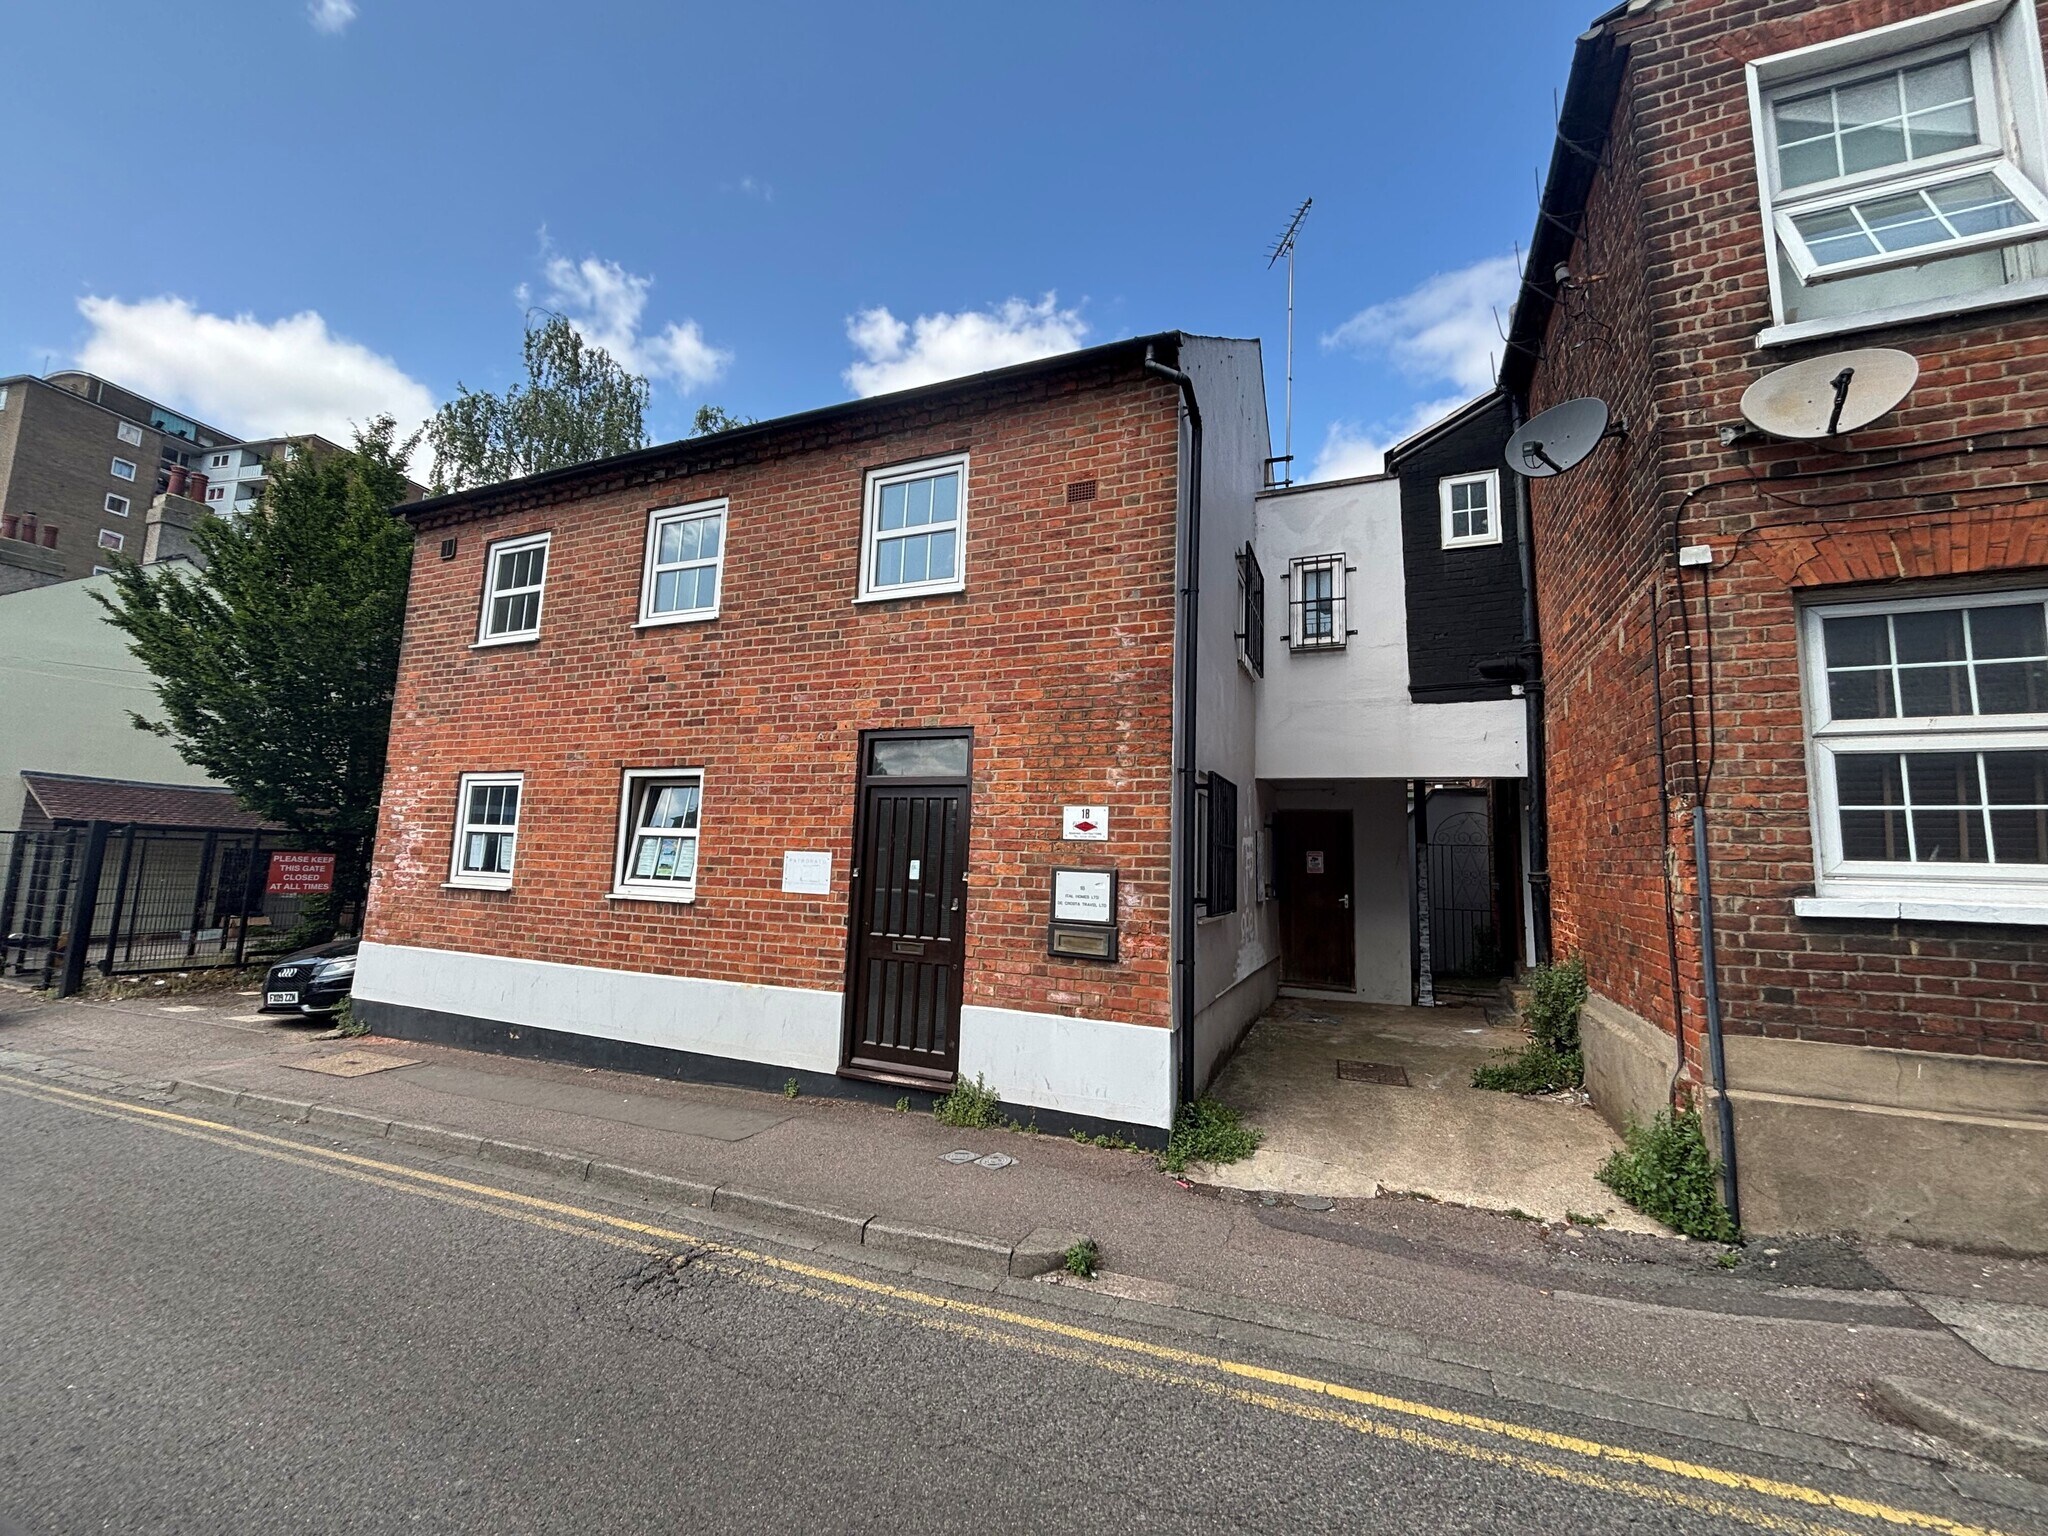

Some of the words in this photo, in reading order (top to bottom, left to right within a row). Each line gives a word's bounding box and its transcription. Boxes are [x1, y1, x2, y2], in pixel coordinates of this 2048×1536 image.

[1082, 808, 1090, 819] 18
[273, 855, 309, 863] PLEASE
[280, 864, 301, 872] THIS
